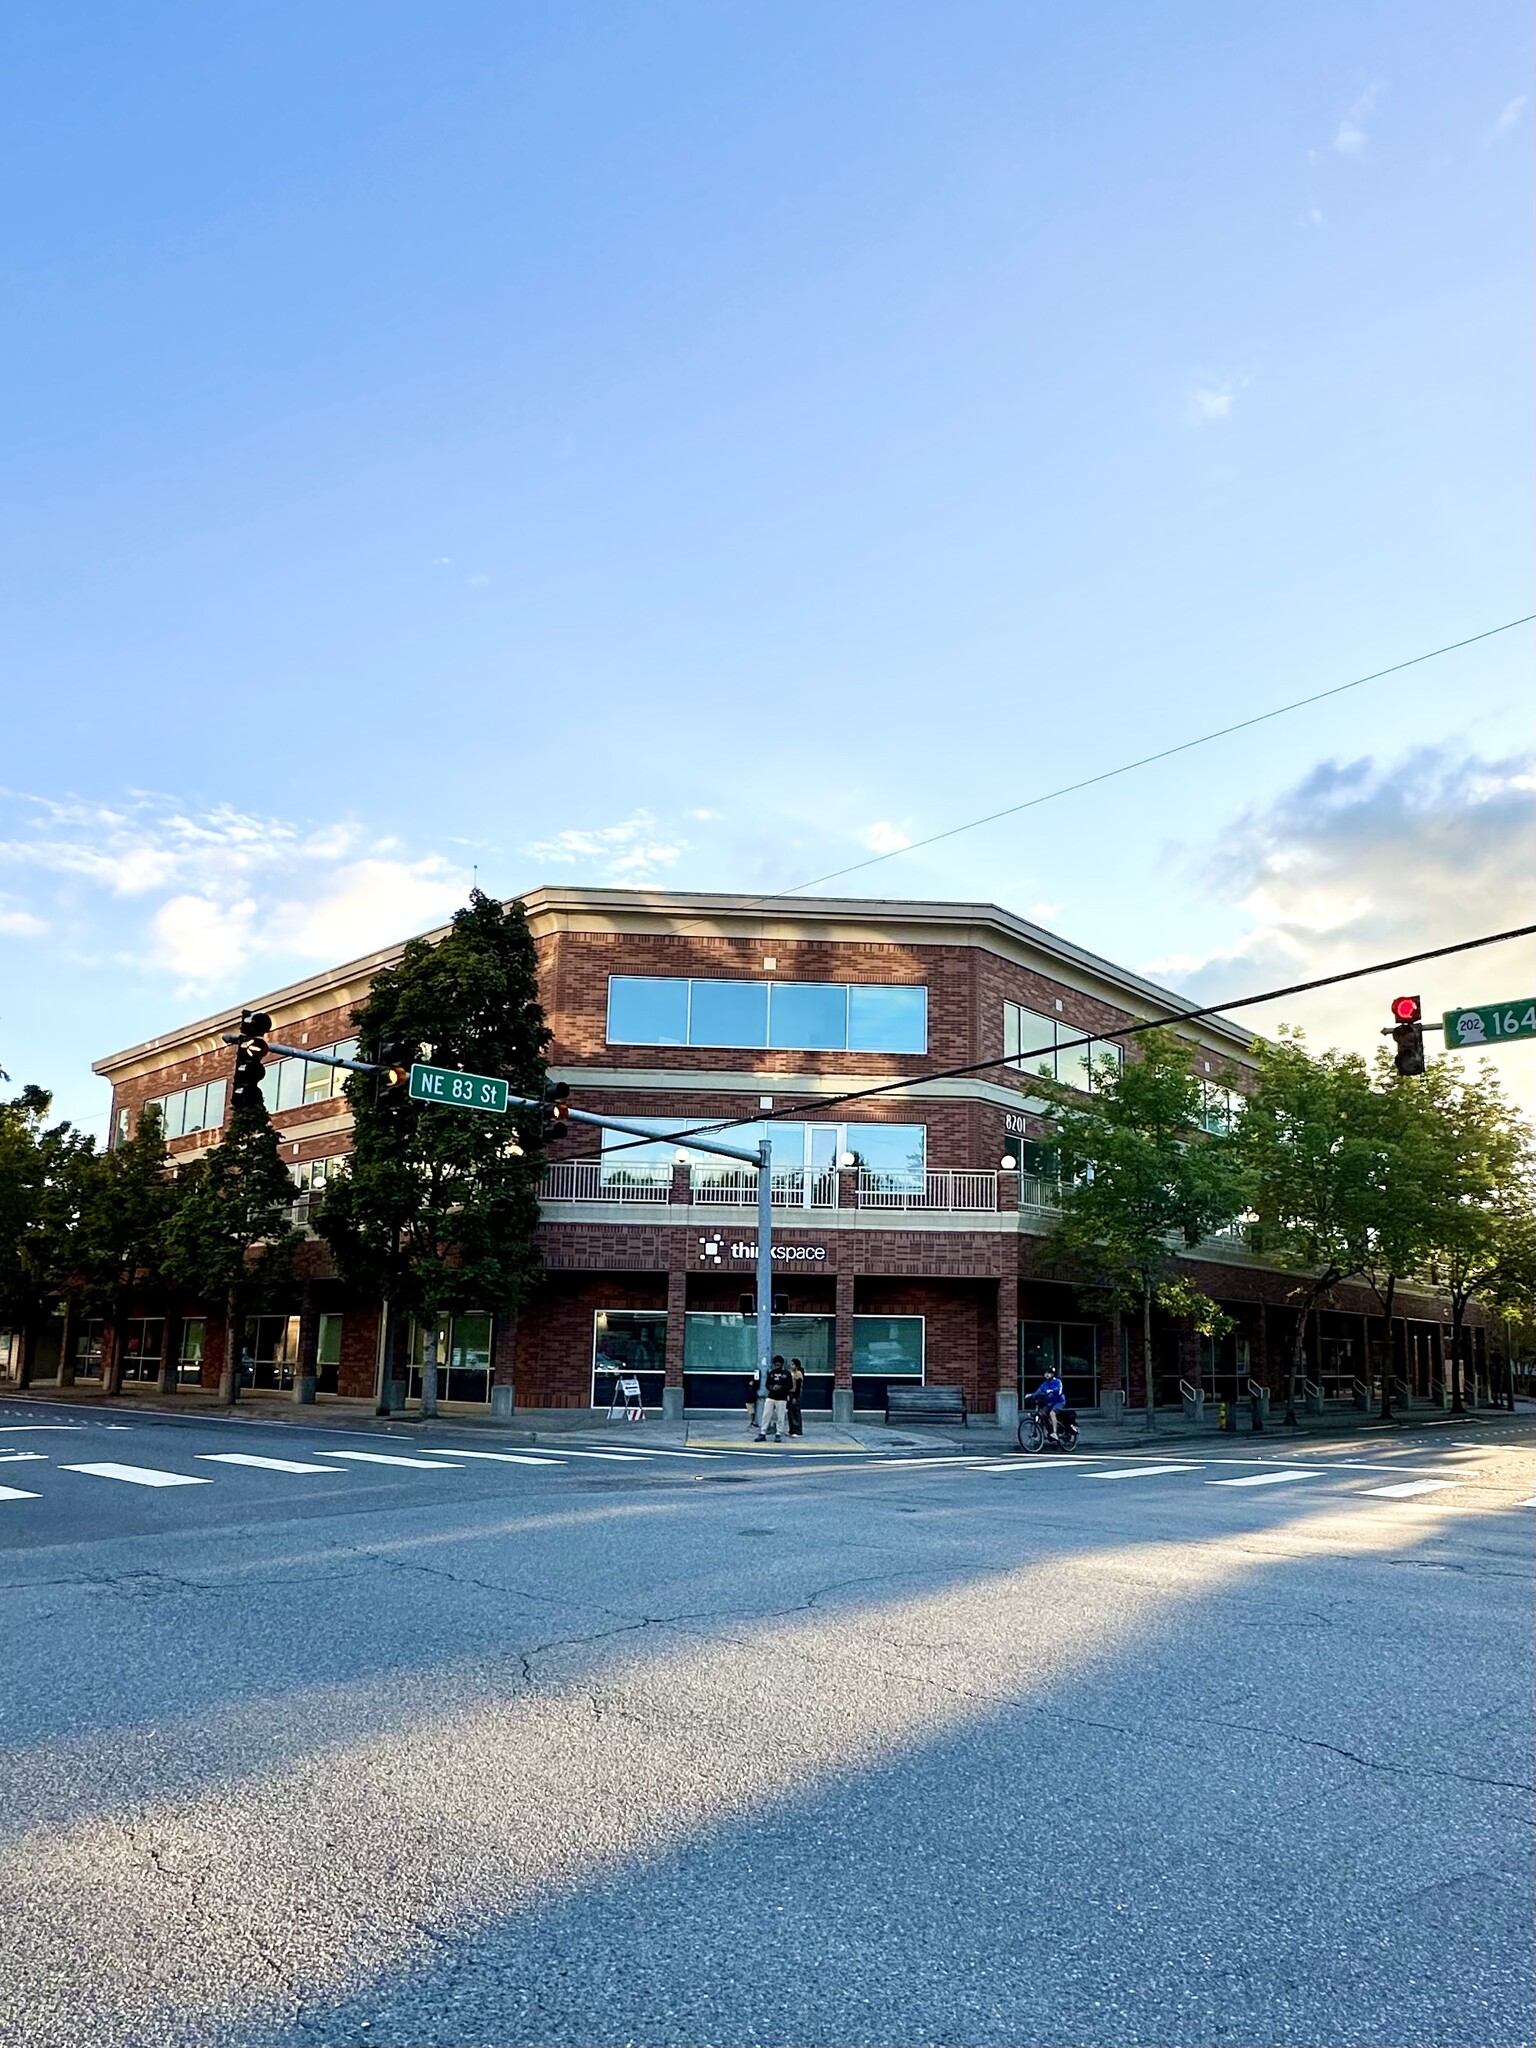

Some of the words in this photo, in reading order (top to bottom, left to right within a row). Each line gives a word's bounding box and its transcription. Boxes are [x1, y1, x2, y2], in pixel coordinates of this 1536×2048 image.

[1460, 1018, 1481, 1031] 202
[1492, 1006, 1536, 1035] 164
[421, 1073, 445, 1095] NE
[452, 1078, 473, 1100] 83
[480, 1084, 498, 1105] St
[1005, 1113, 1026, 1134] 8201
[730, 1241, 826, 1263] thikspace
